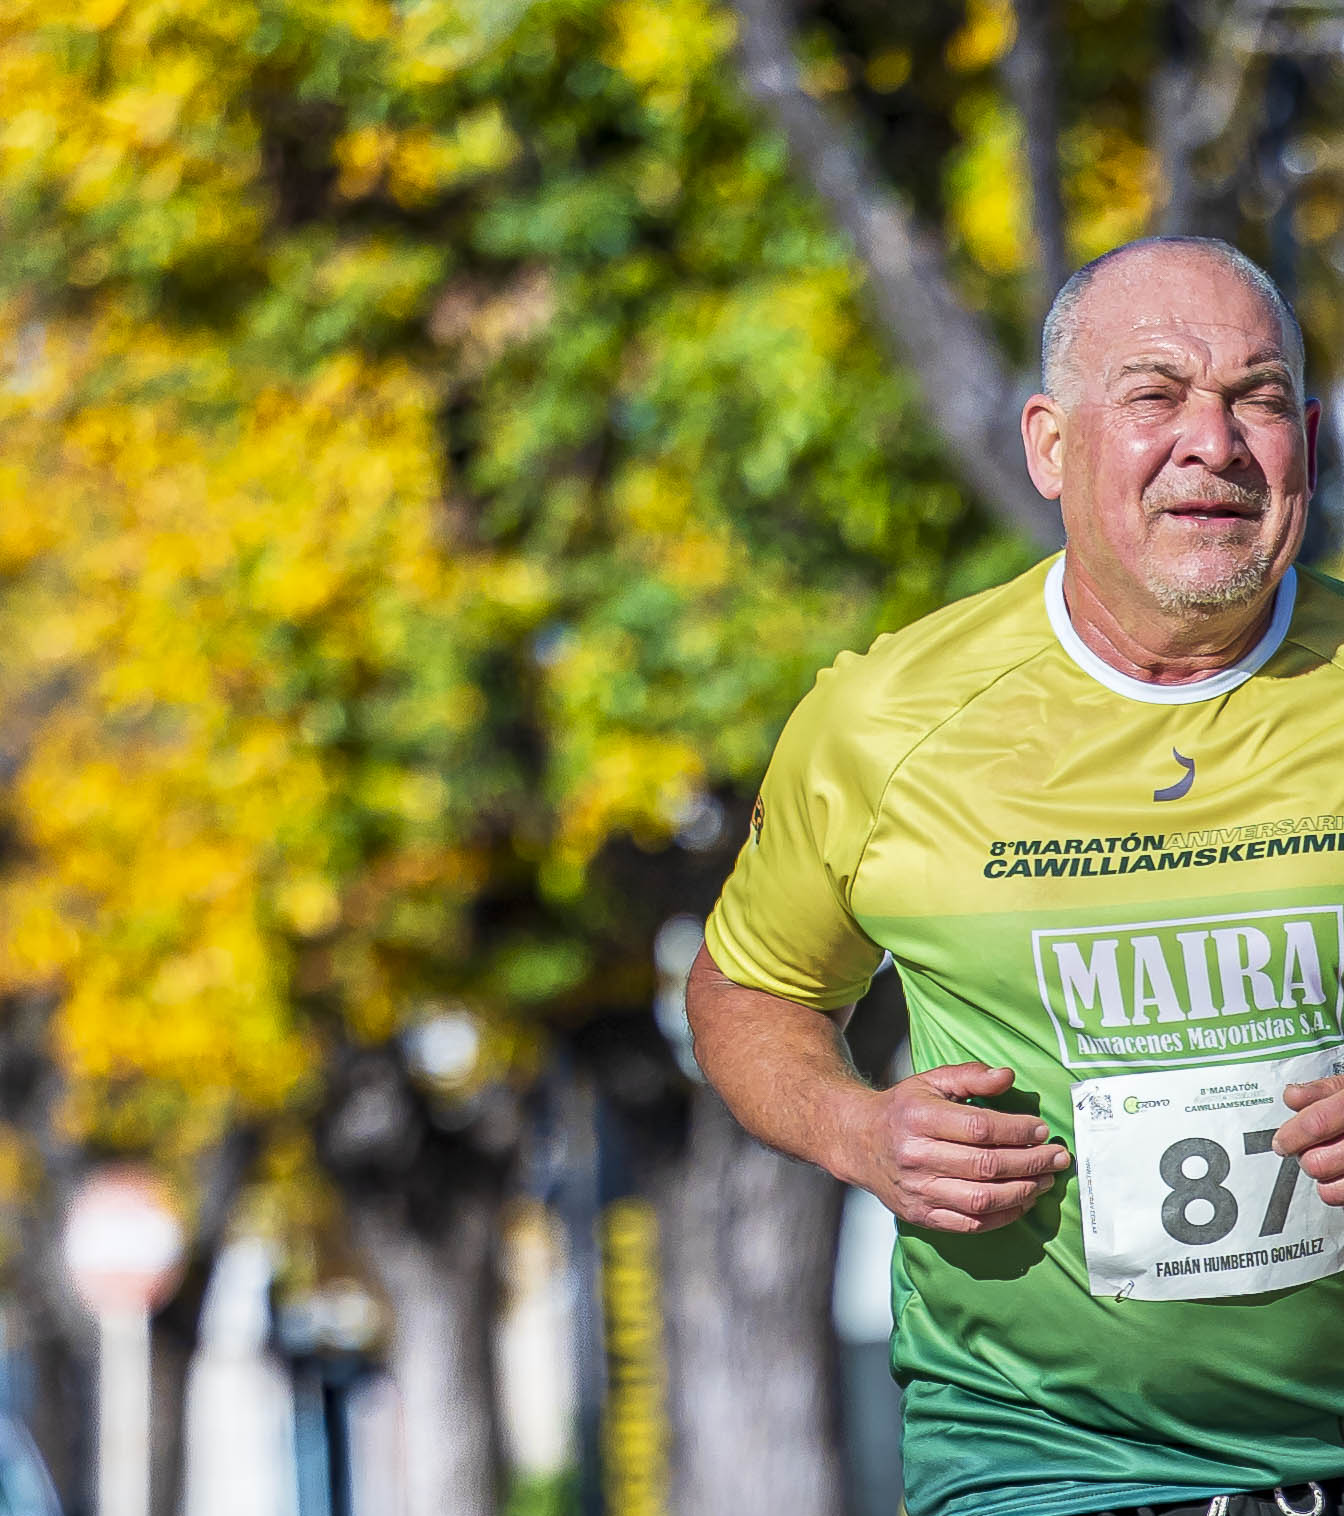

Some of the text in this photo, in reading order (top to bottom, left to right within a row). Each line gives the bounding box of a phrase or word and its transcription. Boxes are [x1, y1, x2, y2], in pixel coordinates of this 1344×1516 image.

[1052, 921, 1327, 1029] MAIRA
[1077, 1011, 1331, 1056] Almacenes Mayoristas S.A.
[1159, 1127, 1303, 1246] 87
[1156, 1237, 1325, 1278] FABIÁN HUMBERTO GONZÁLEZ
